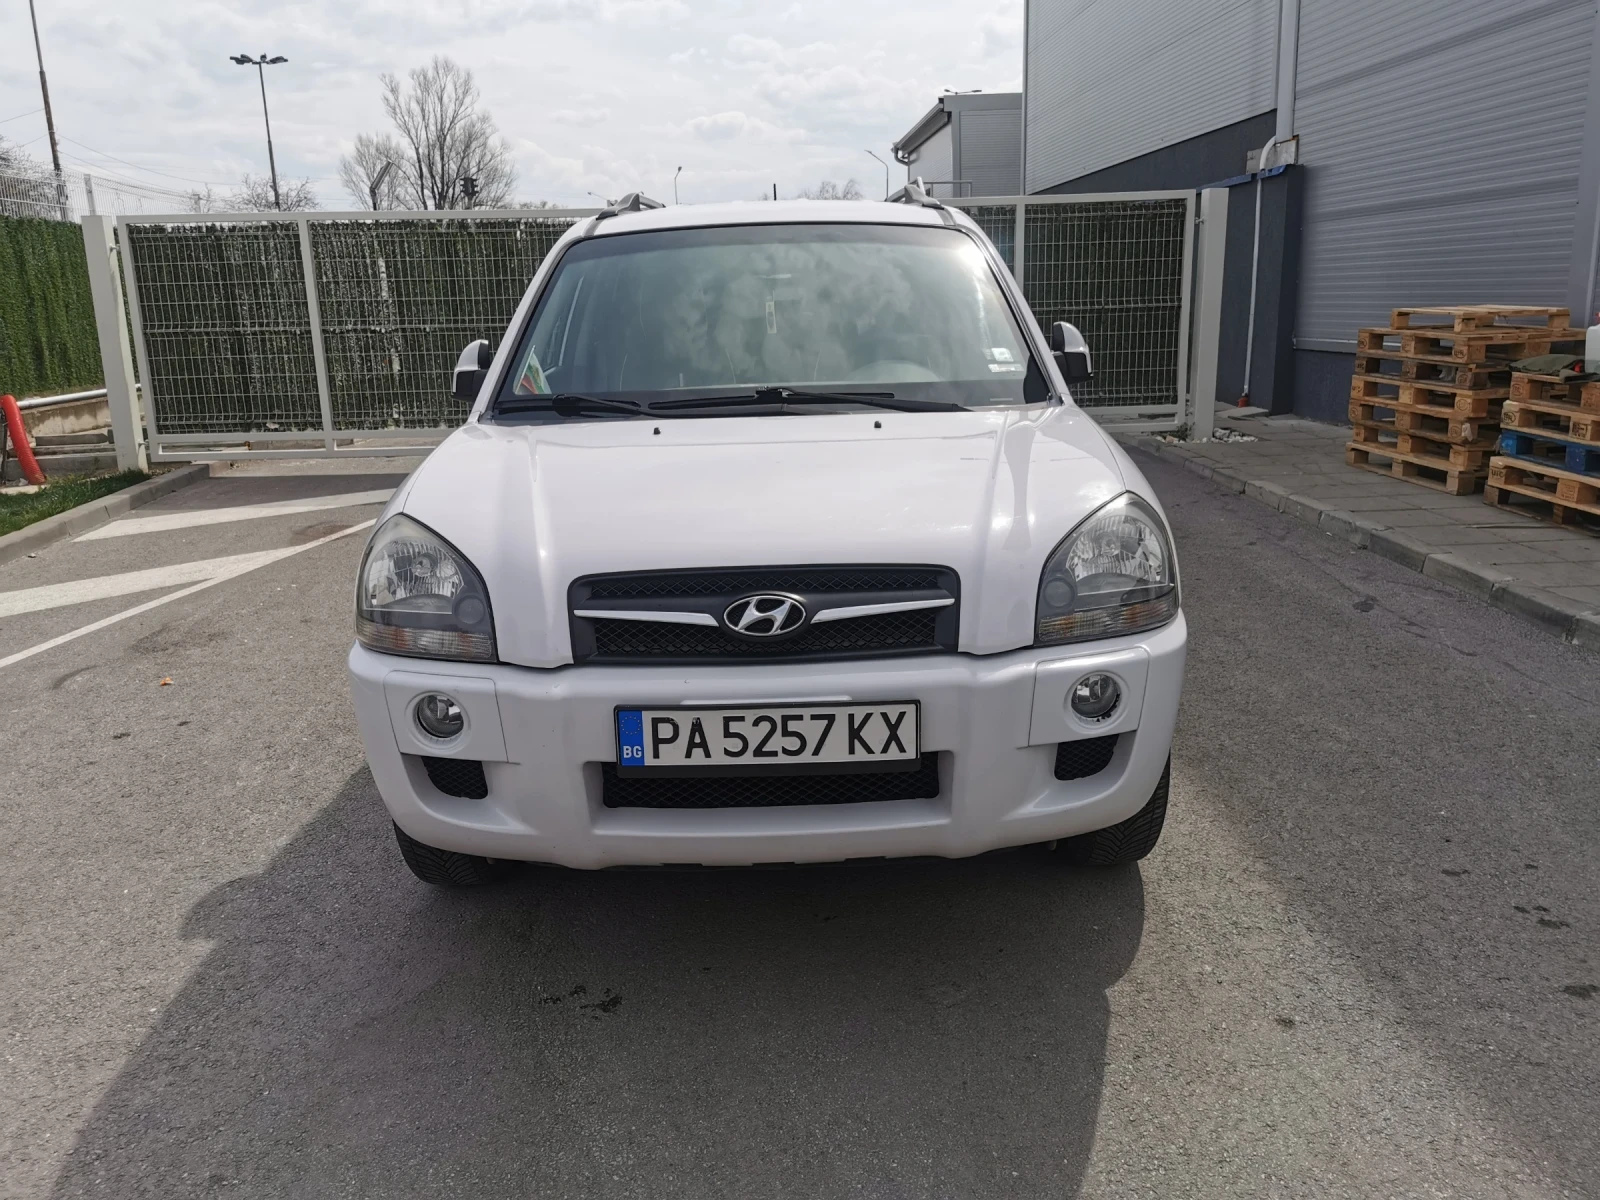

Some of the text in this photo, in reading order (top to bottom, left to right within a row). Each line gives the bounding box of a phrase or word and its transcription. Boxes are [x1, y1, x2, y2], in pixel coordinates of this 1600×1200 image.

[651, 711, 907, 759] PA 5257 KX
[623, 745, 642, 758] BG
